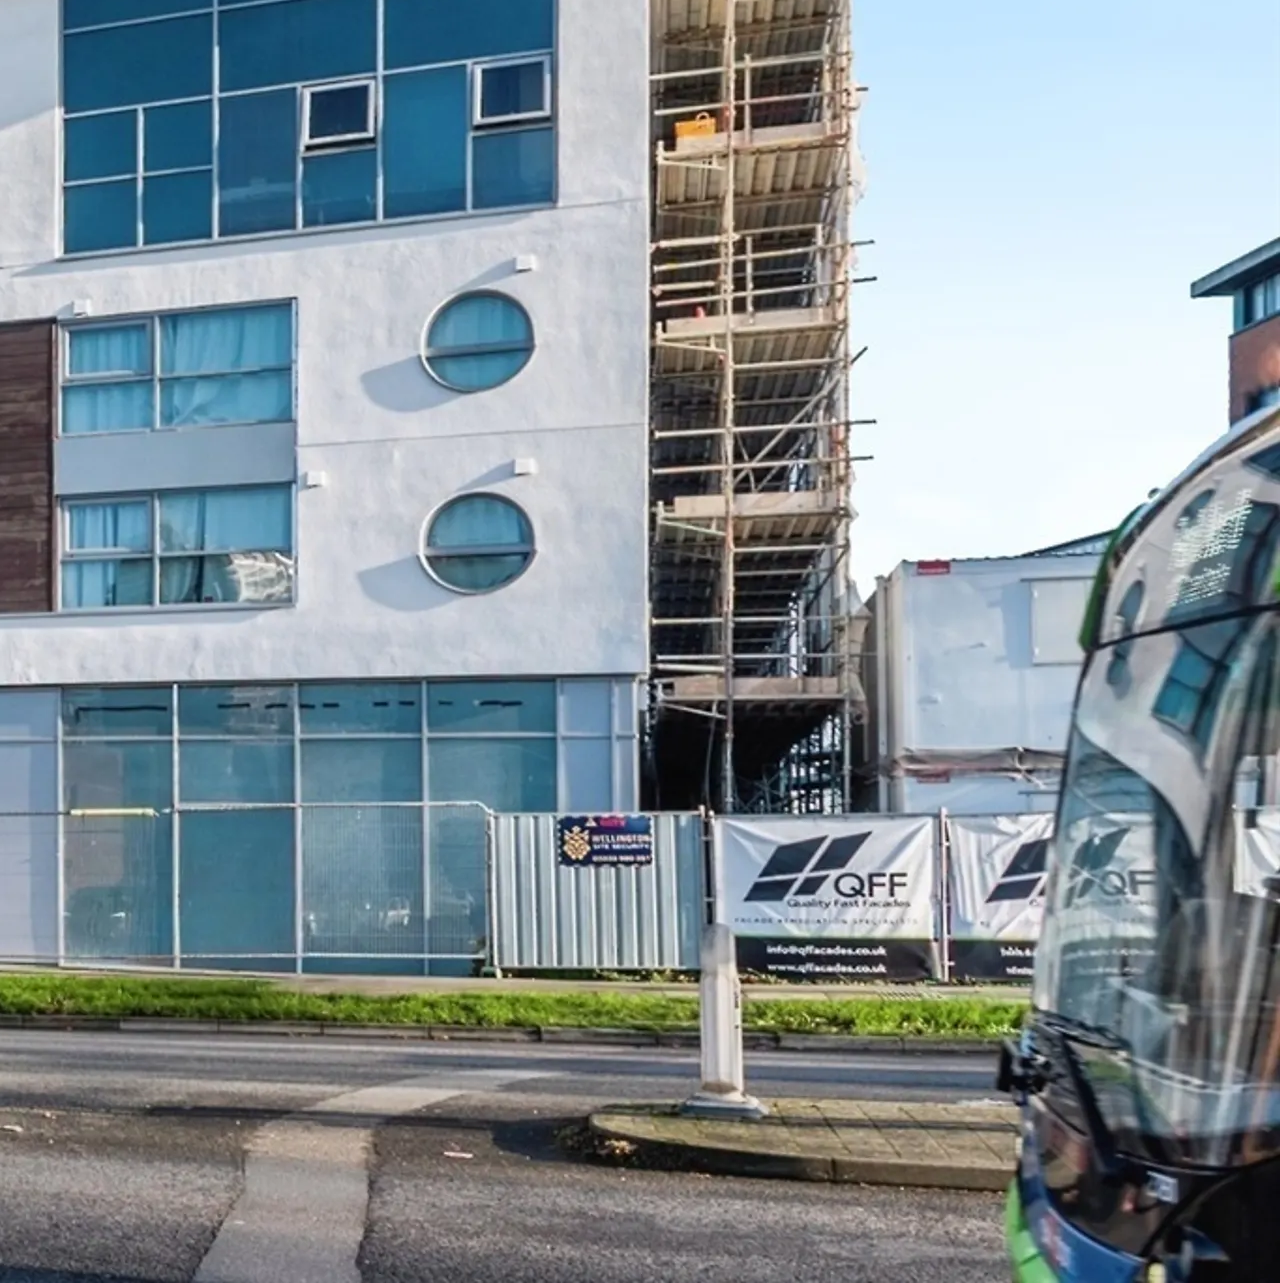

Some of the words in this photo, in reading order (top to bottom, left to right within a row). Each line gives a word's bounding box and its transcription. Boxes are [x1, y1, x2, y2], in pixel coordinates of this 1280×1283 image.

[592, 834, 651, 843] WELLINGTON
[833, 872, 908, 898] QFF
[1099, 870, 1158, 896] QF
[787, 898, 832, 910] Quality
[834, 898, 860, 908] Fast
[862, 898, 911, 908] Facades
[766, 944, 887, 957] info@qffacades.co.uk
[767, 963, 888, 974] www.qffacades.co.uk
